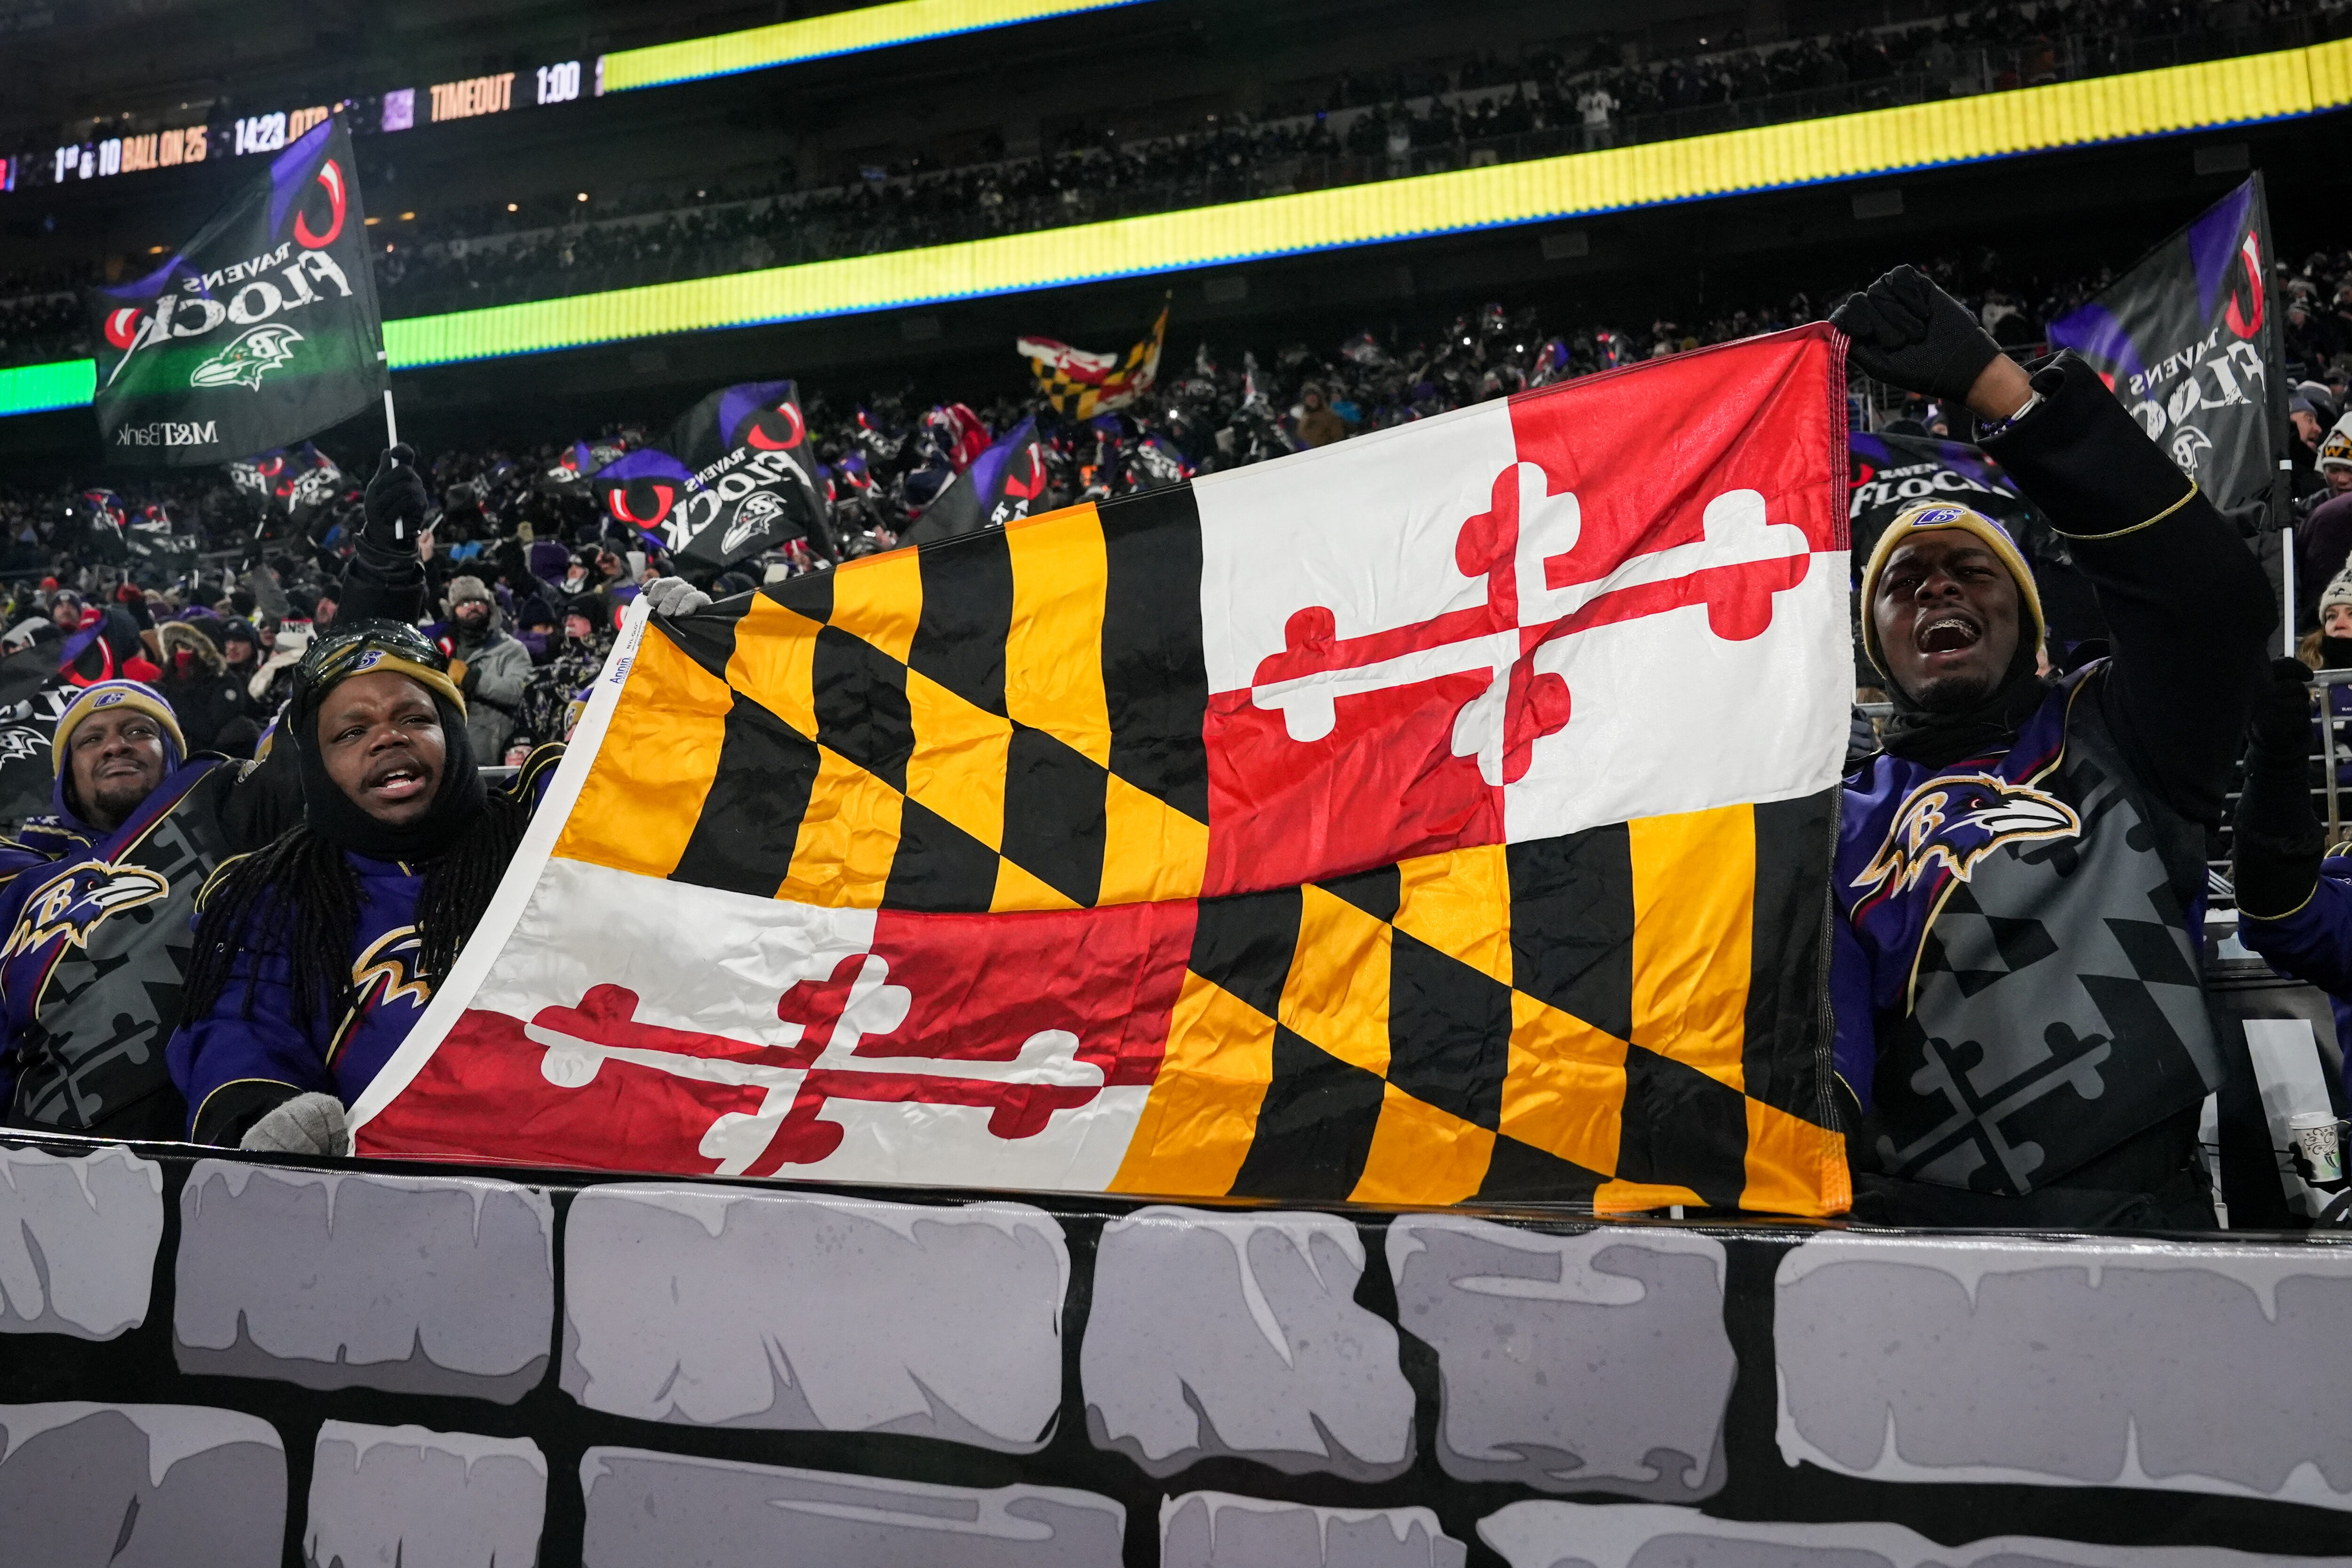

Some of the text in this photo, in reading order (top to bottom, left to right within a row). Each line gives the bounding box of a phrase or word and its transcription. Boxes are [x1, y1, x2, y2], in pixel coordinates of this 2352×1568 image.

[430, 60, 580, 122] TIMEOUT 1:00
[99, 138, 122, 176] 10
[120, 133, 159, 173] BALL
[159, 128, 185, 167] ON
[184, 124, 208, 163] 25
[1877, 462, 1940, 480] RAVEN
[609, 657, 631, 685] Annin
